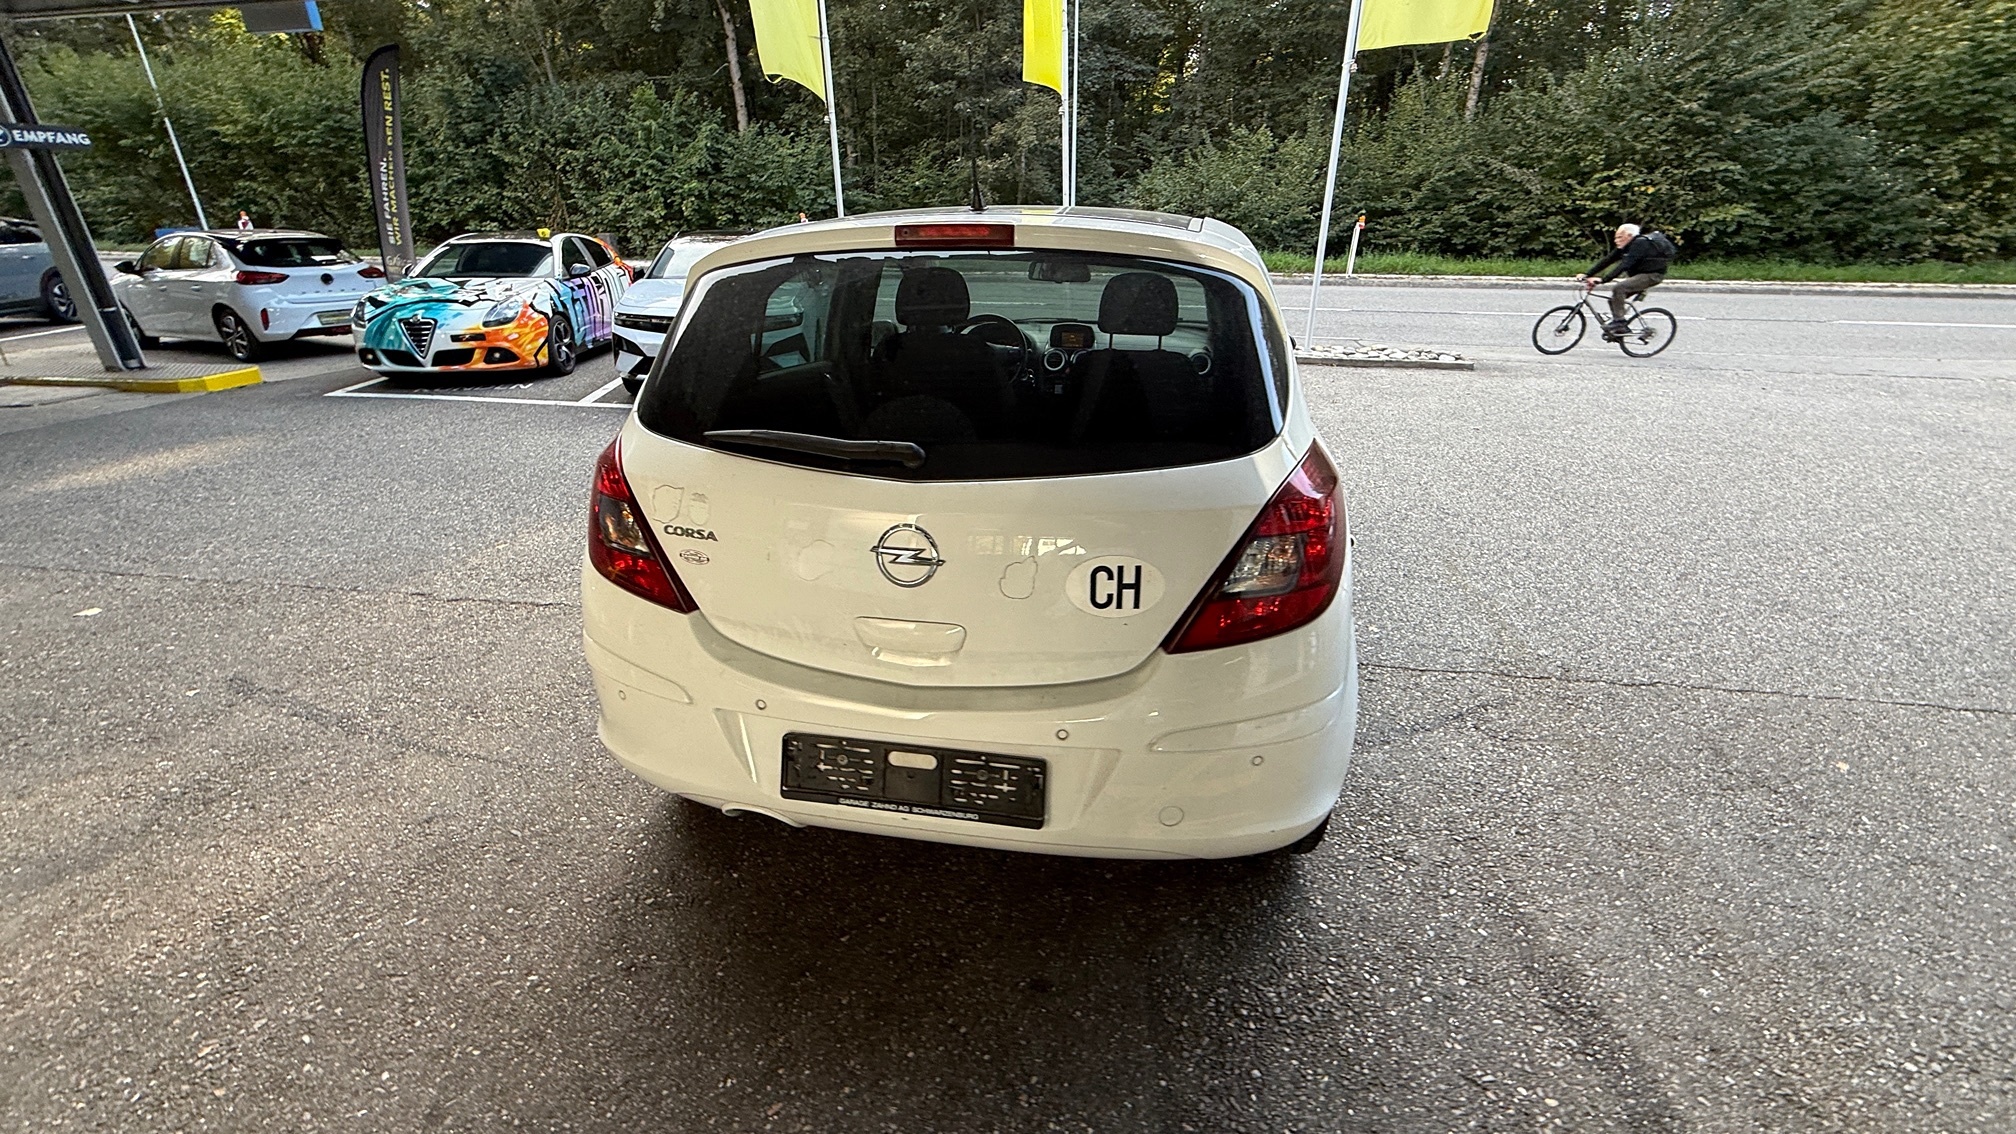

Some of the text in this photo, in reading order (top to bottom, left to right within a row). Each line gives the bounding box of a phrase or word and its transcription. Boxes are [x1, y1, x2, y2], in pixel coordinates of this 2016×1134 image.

[380, 68, 393, 111] REST.
[11, 129, 92, 145] EMPFANG
[384, 115, 394, 146] DEN
[387, 150, 398, 213] MACHEN
[380, 157, 396, 245] SIE FAHREN.
[392, 217, 402, 245] WIR
[663, 524, 719, 542] CORSA
[1090, 565, 1142, 609] CH
[838, 797, 980, 820] GARAGE ZAHND AG SCHWARZENBURG
